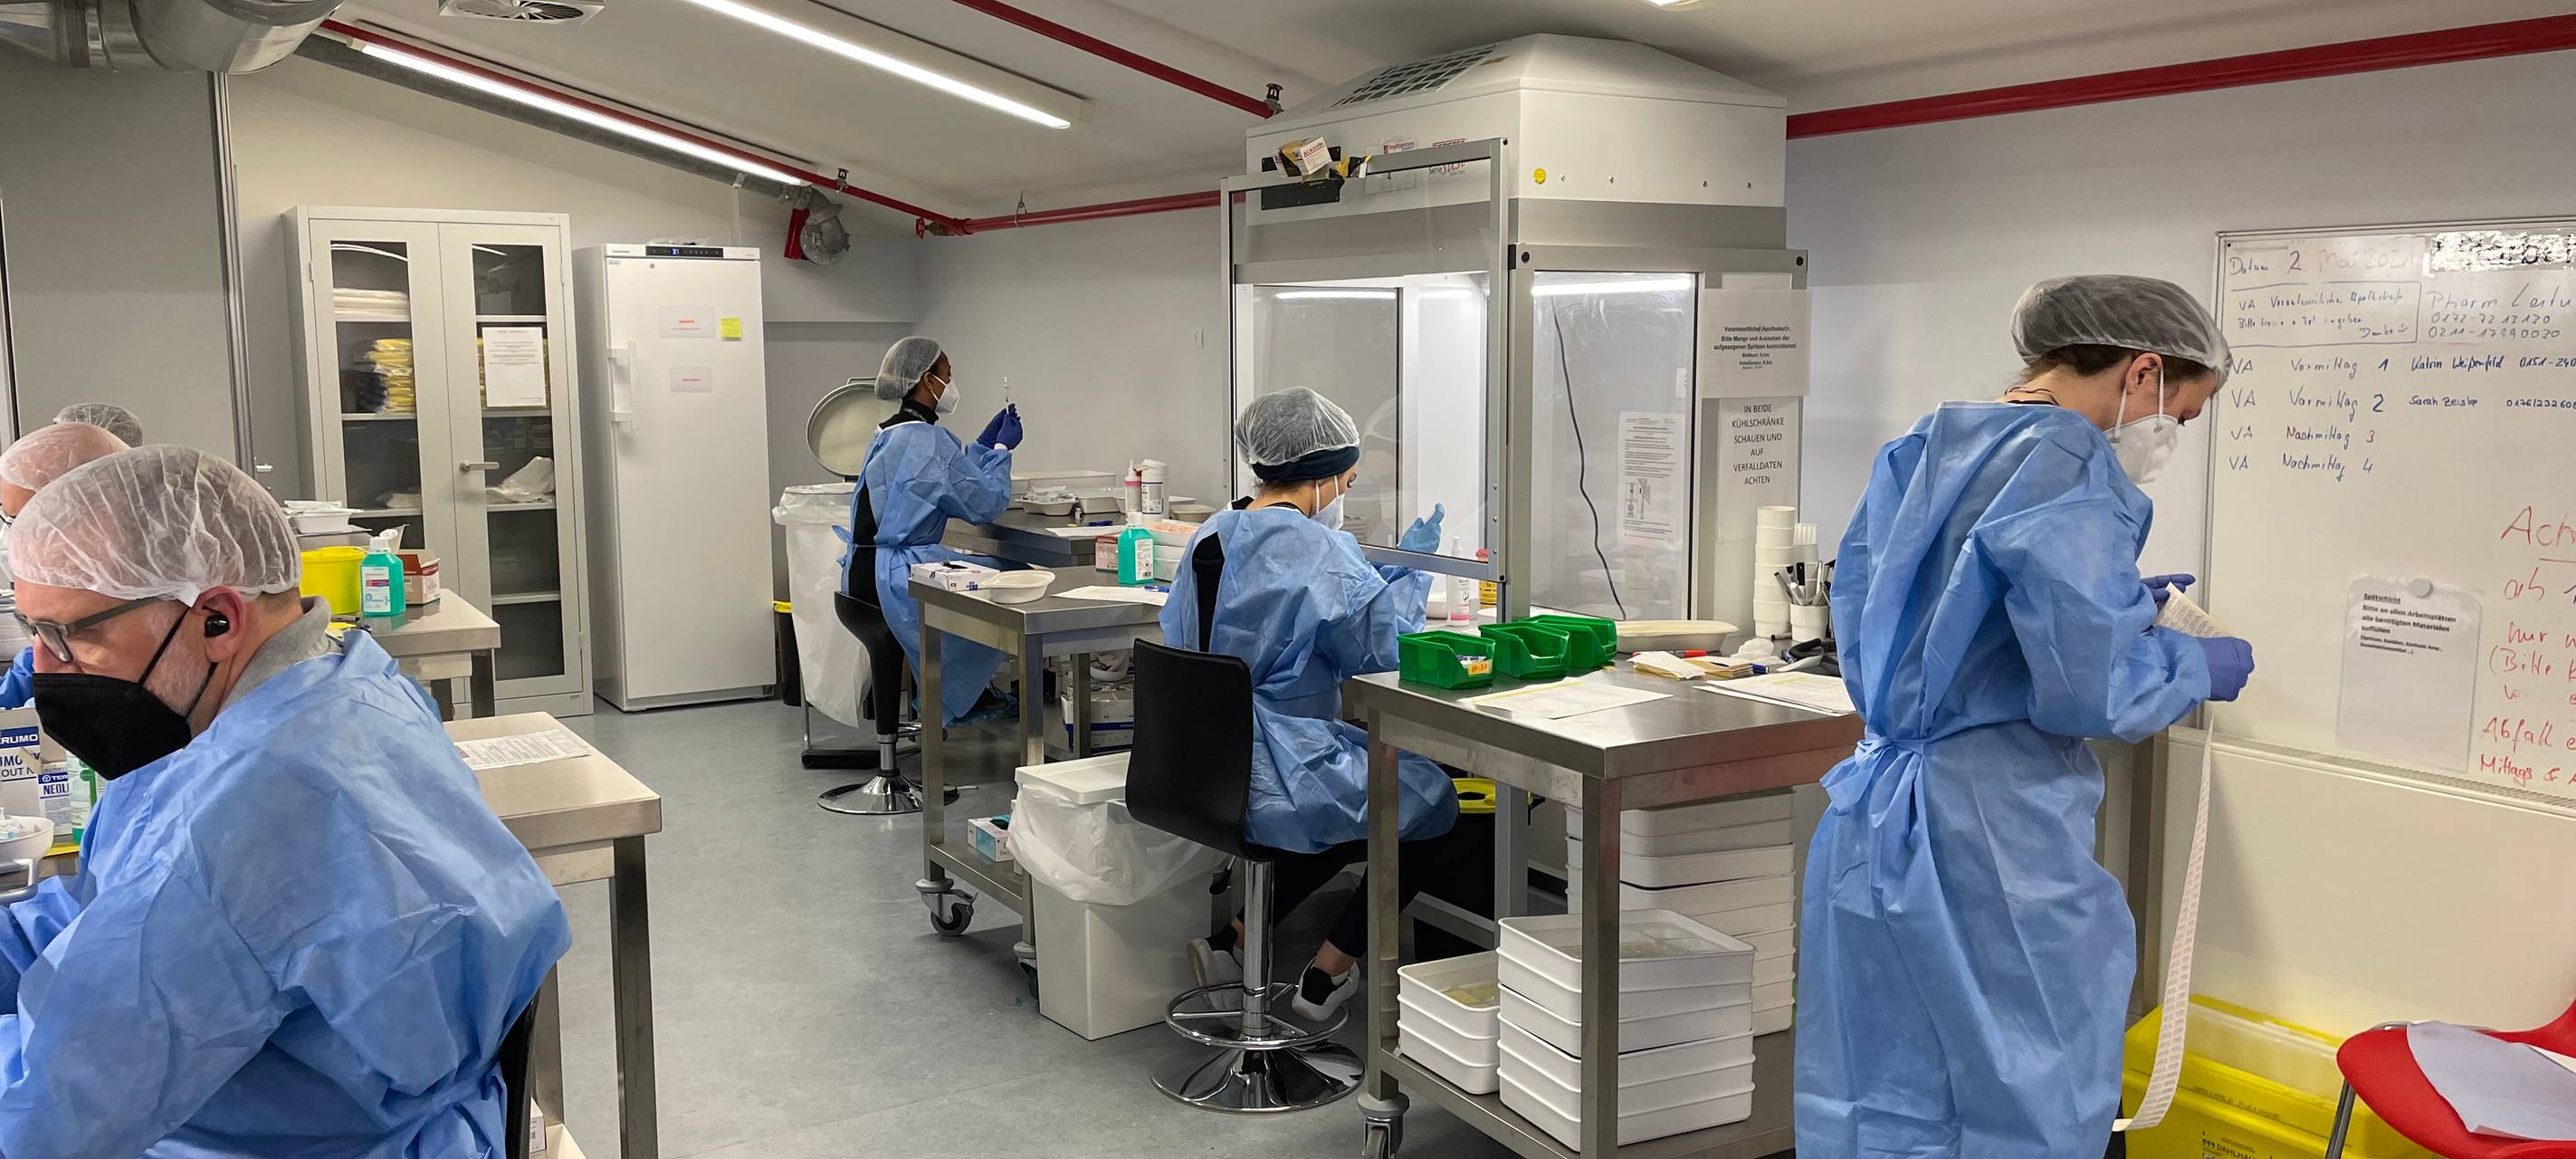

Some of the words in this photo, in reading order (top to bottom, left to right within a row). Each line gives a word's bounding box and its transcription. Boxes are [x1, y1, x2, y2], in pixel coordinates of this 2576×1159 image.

[2288, 250, 2302, 273] 2
[2232, 358, 2254, 375] VA
[2291, 356, 2358, 379] Vormittag
[2378, 358, 2389, 371] 1
[1744, 405, 1751, 414] IN
[1752, 404, 1772, 413] BEIDE
[2231, 388, 2256, 408] VA
[2289, 385, 2358, 422] Vormittag
[2371, 393, 2385, 413] 2
[1732, 417, 1785, 428] KÜHLSCHRÄNKE
[1734, 434, 1765, 444] SCHAUEN
[1766, 433, 1782, 442] UND
[2230, 425, 2253, 440] VA
[2366, 429, 2376, 444] 3
[1751, 448, 1764, 456] AUF
[1733, 461, 1782, 472] VERFALLDATEN
[2228, 455, 2249, 470] VA
[2362, 457, 2375, 474] 4
[1744, 475, 1770, 485] ACHTEN
[2362, 604, 2379, 612] Bitte
[0, 733, 38, 744] RUMO
